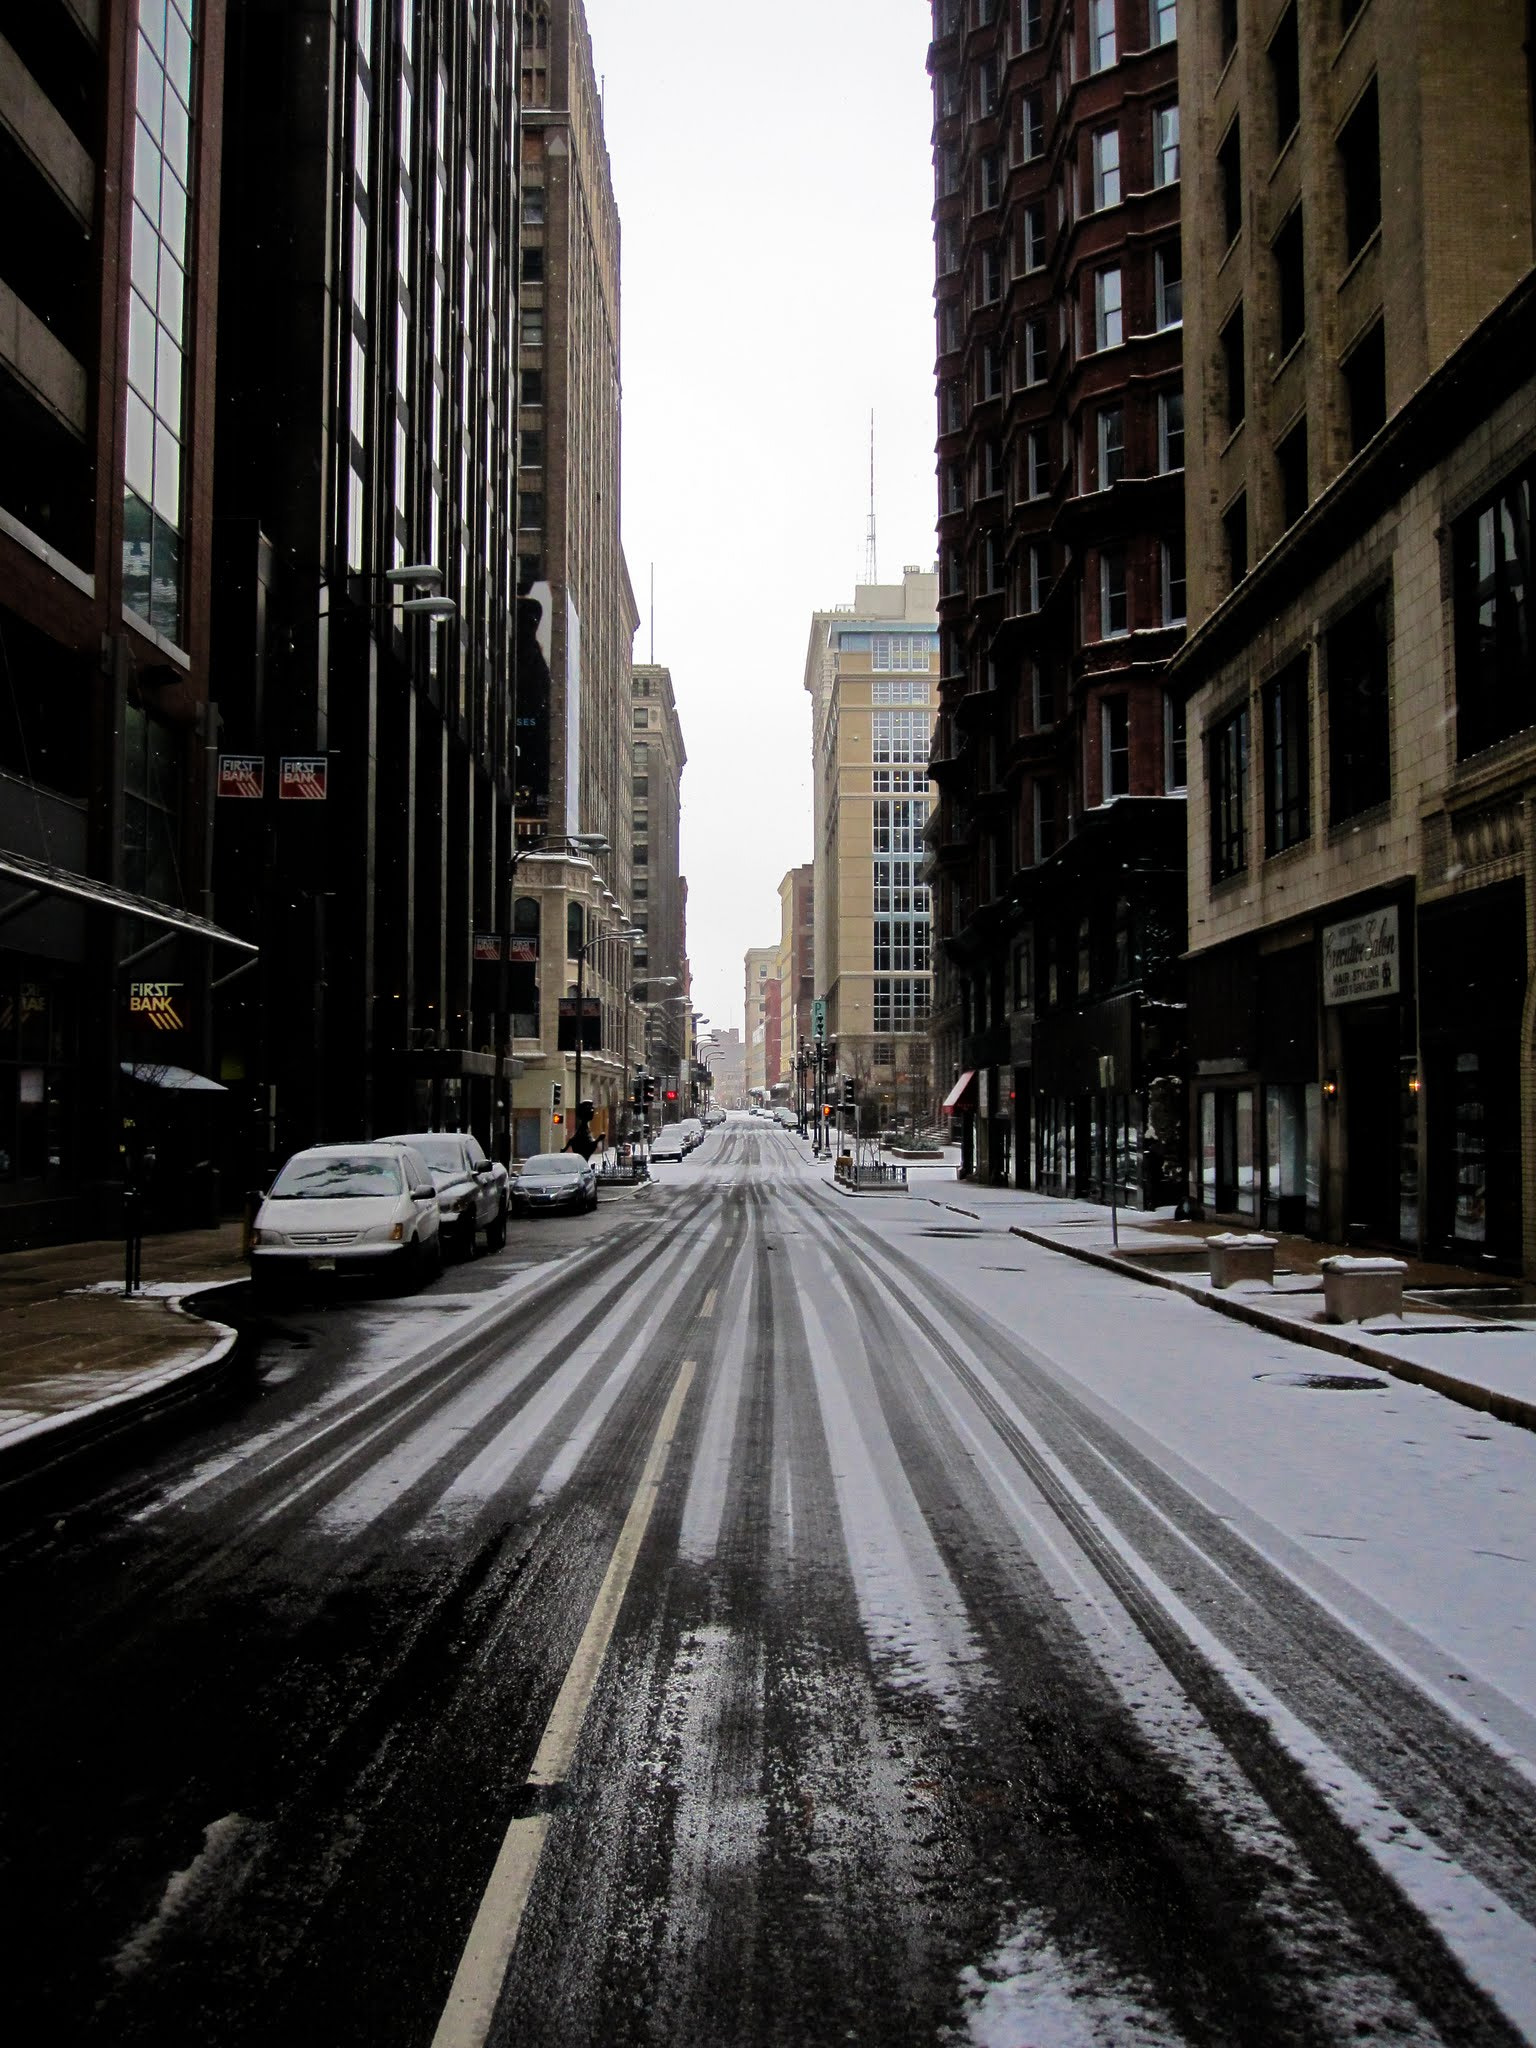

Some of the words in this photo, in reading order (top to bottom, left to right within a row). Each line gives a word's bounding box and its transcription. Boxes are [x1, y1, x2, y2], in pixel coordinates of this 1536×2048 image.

[223, 759, 263, 771] FIRST
[284, 761, 325, 773] FIRST
[223, 771, 257, 782] BANK
[284, 773, 317, 785] BANK
[1364, 917, 1395, 961] Salon
[1333, 971, 1350, 985] HAIR
[1353, 964, 1379, 982] STYLING
[130, 982, 184, 997] FIRST
[130, 996, 176, 1012] BANK
